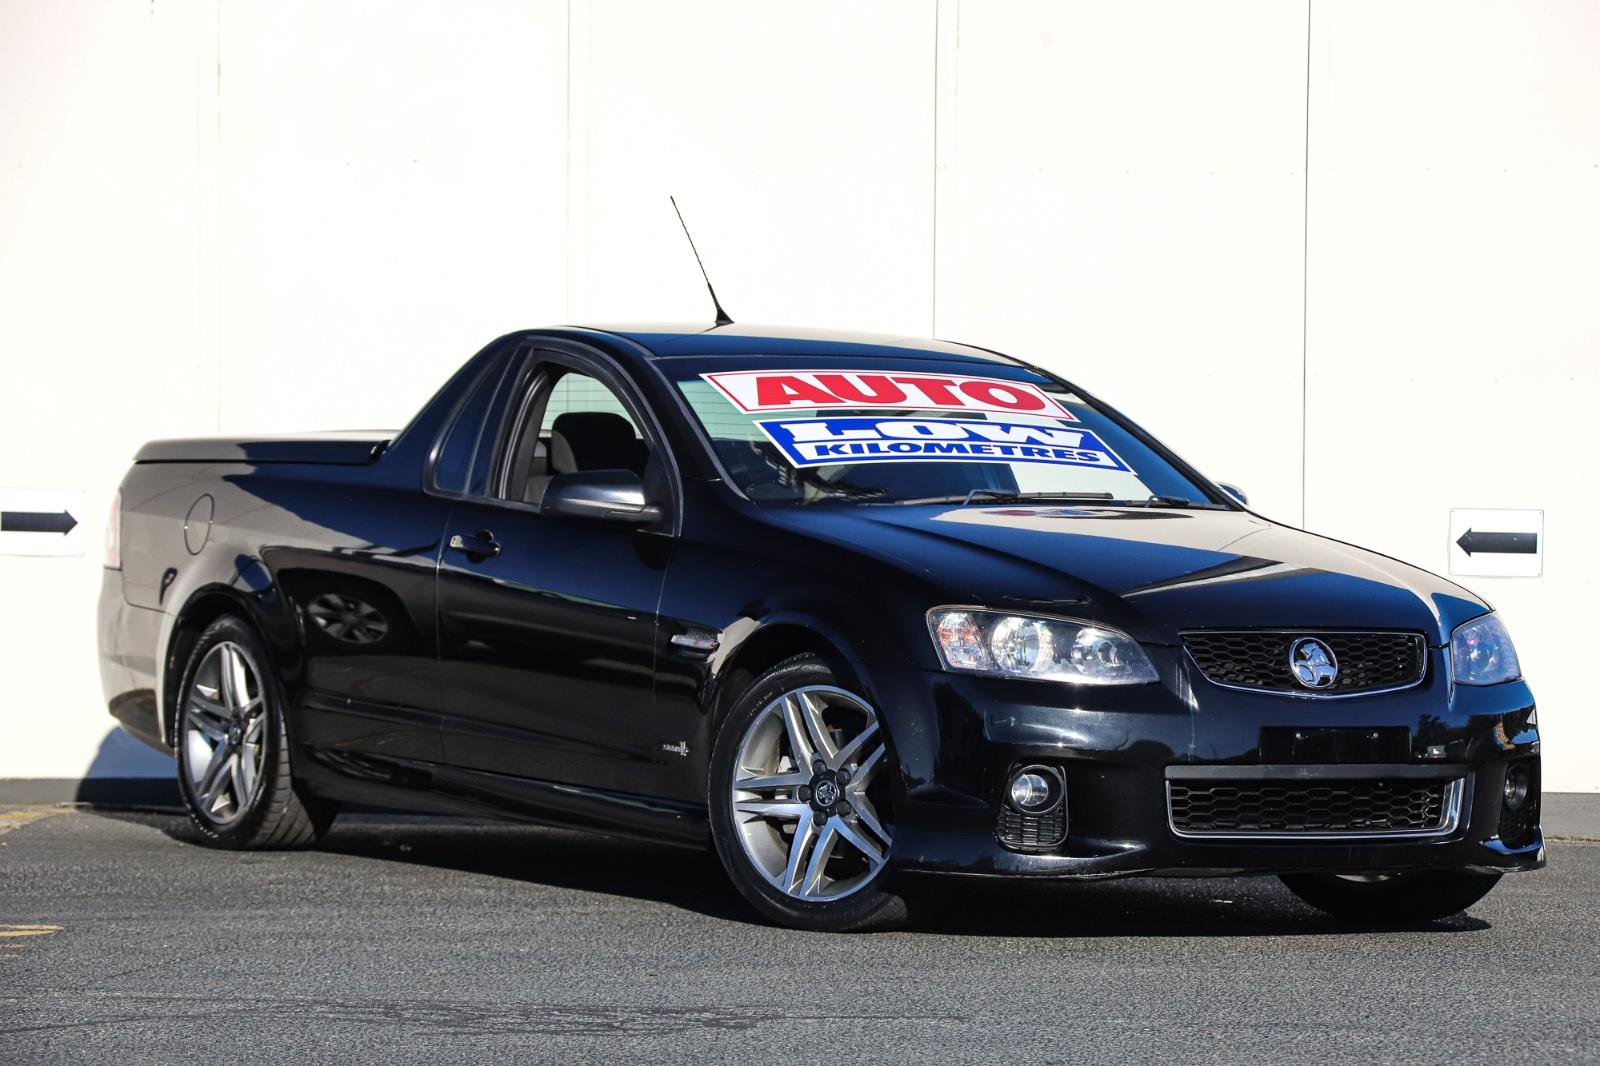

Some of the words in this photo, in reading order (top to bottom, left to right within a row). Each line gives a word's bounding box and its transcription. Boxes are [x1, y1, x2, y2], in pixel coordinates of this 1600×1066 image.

[756, 374, 1046, 411] AUTO
[779, 421, 1084, 448] LOW
[814, 442, 1101, 462] KILOMETRES
